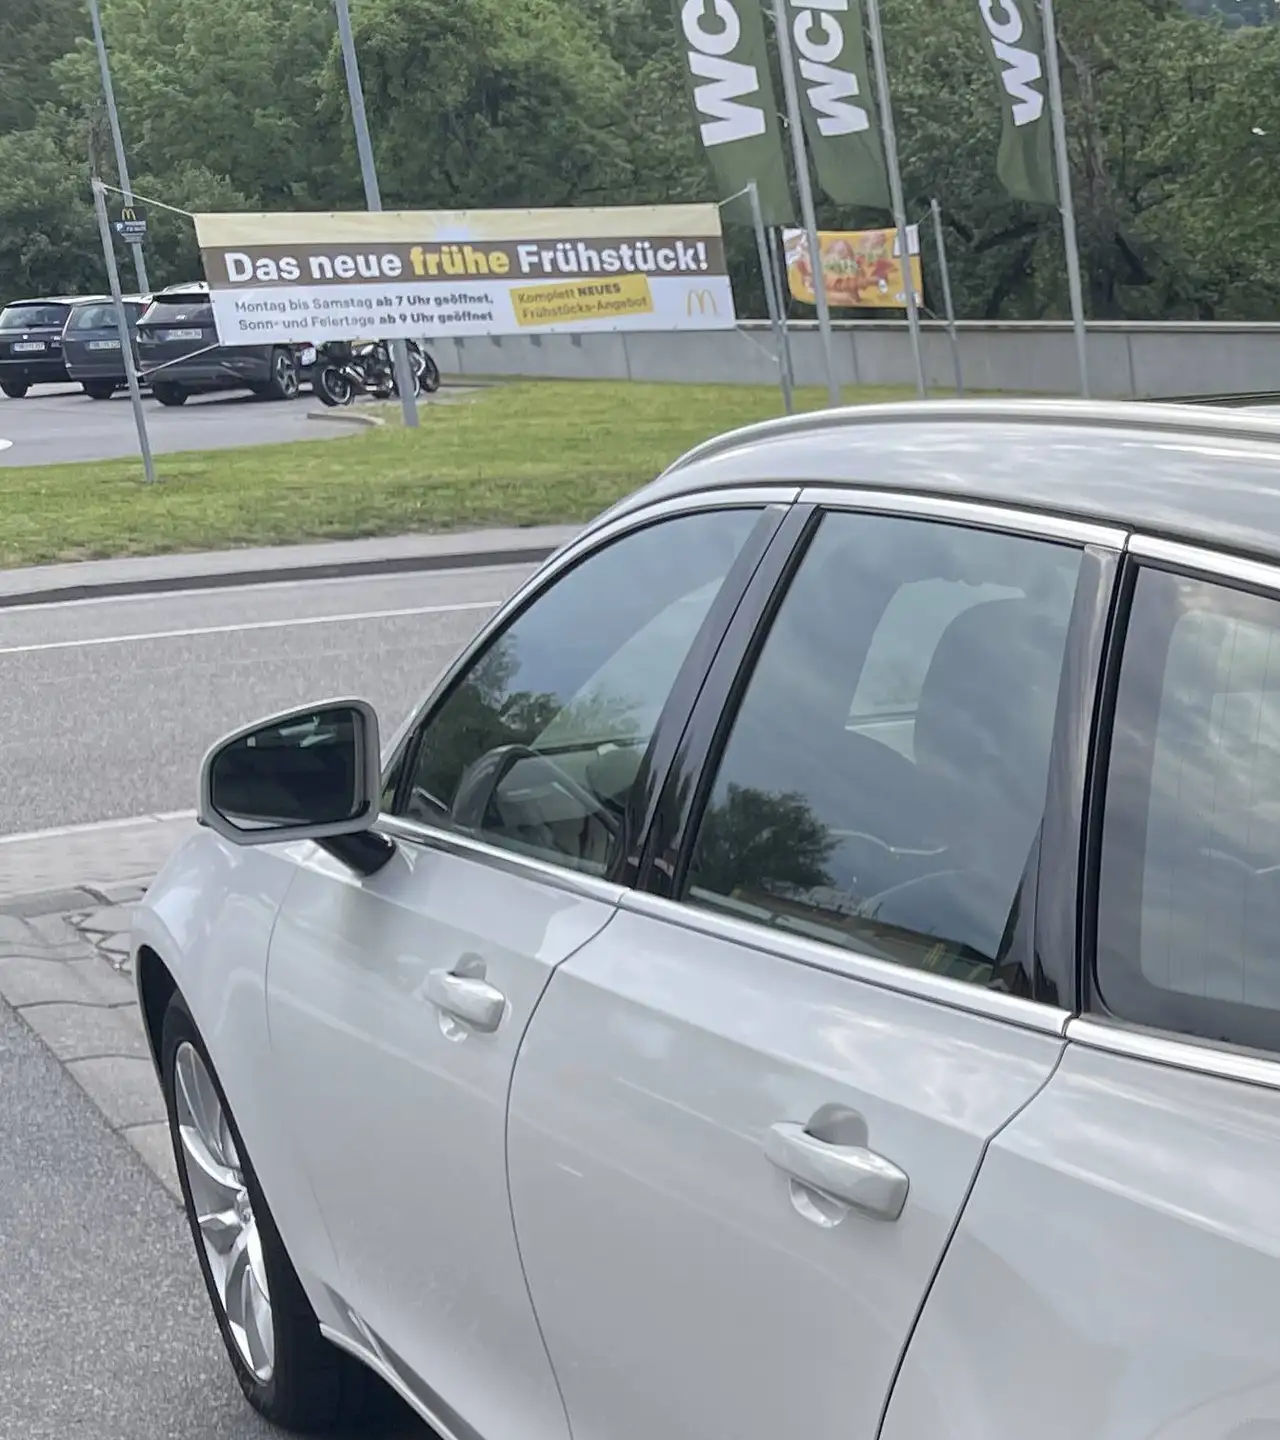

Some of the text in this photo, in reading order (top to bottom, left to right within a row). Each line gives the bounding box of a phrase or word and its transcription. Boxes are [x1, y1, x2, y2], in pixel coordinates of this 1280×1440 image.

[224, 240, 709, 282] Das neue frühe Frühstück!
[235, 292, 494, 313] Montag bis Samstag ab 7 Uhr geöffnet,
[517, 283, 621, 303] Komplett NEUES
[522, 296, 648, 318] Frühstücks-Angebot
[239, 311, 493, 330] Sonn- und Feiertage ab 9 Uhr geöffnet
